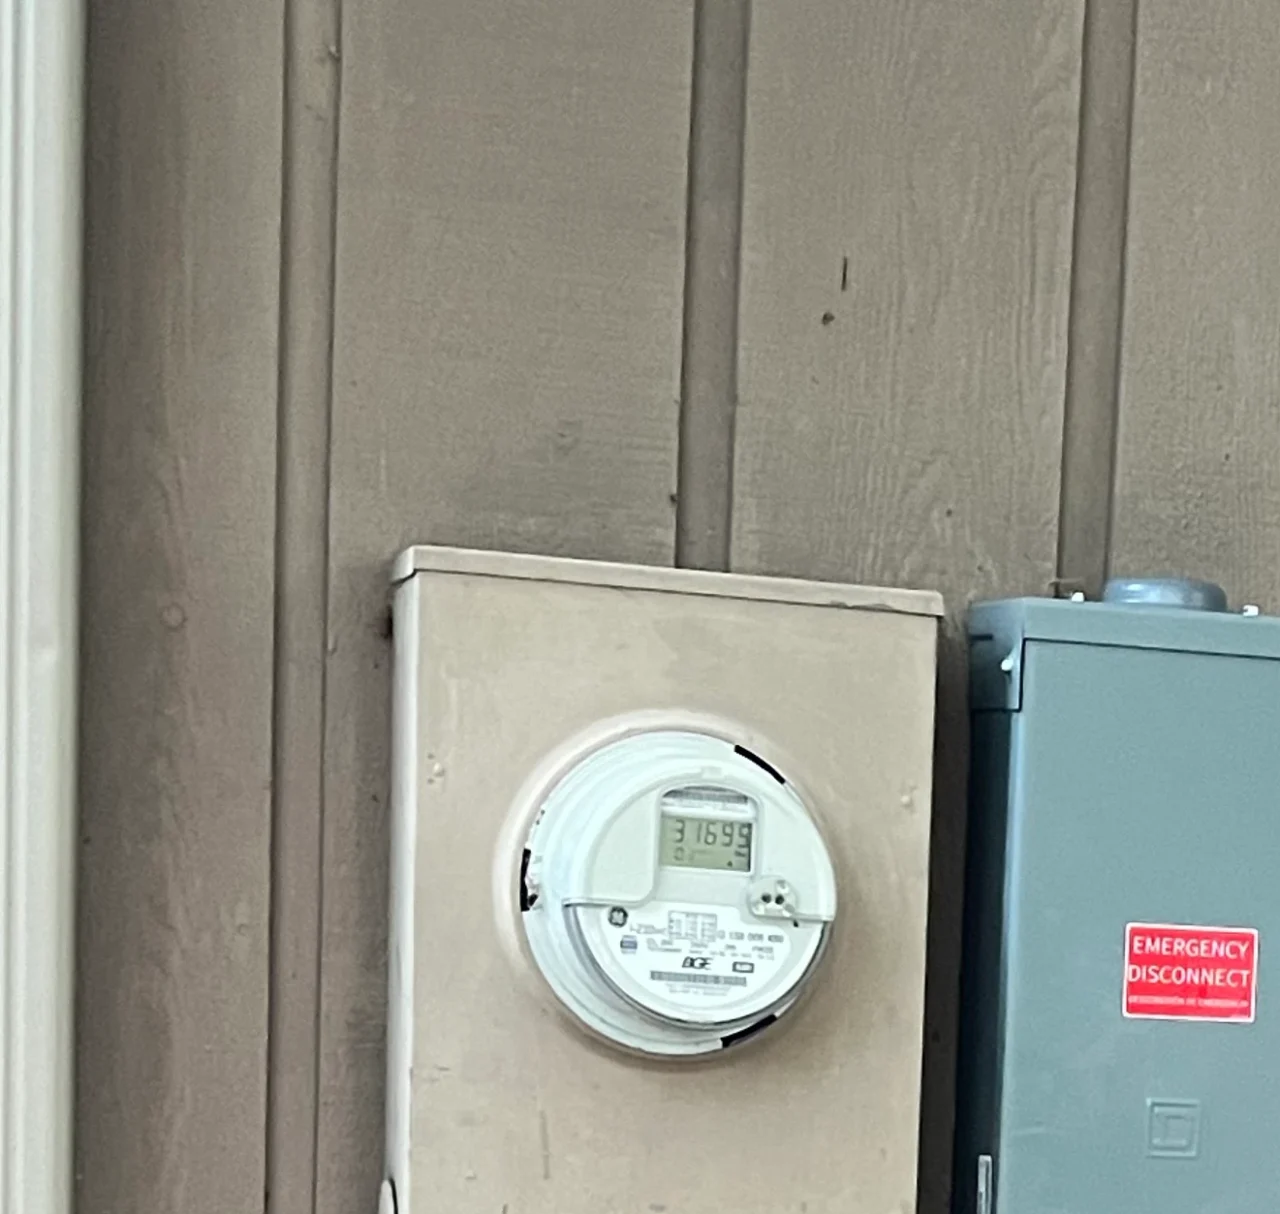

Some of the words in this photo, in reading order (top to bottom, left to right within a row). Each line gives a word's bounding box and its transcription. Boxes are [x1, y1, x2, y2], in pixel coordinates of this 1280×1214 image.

[673, 818, 749, 848] 31699
[1132, 935, 1250, 960] EMERGENCY
[1128, 964, 1251, 988] DISCONNECT
